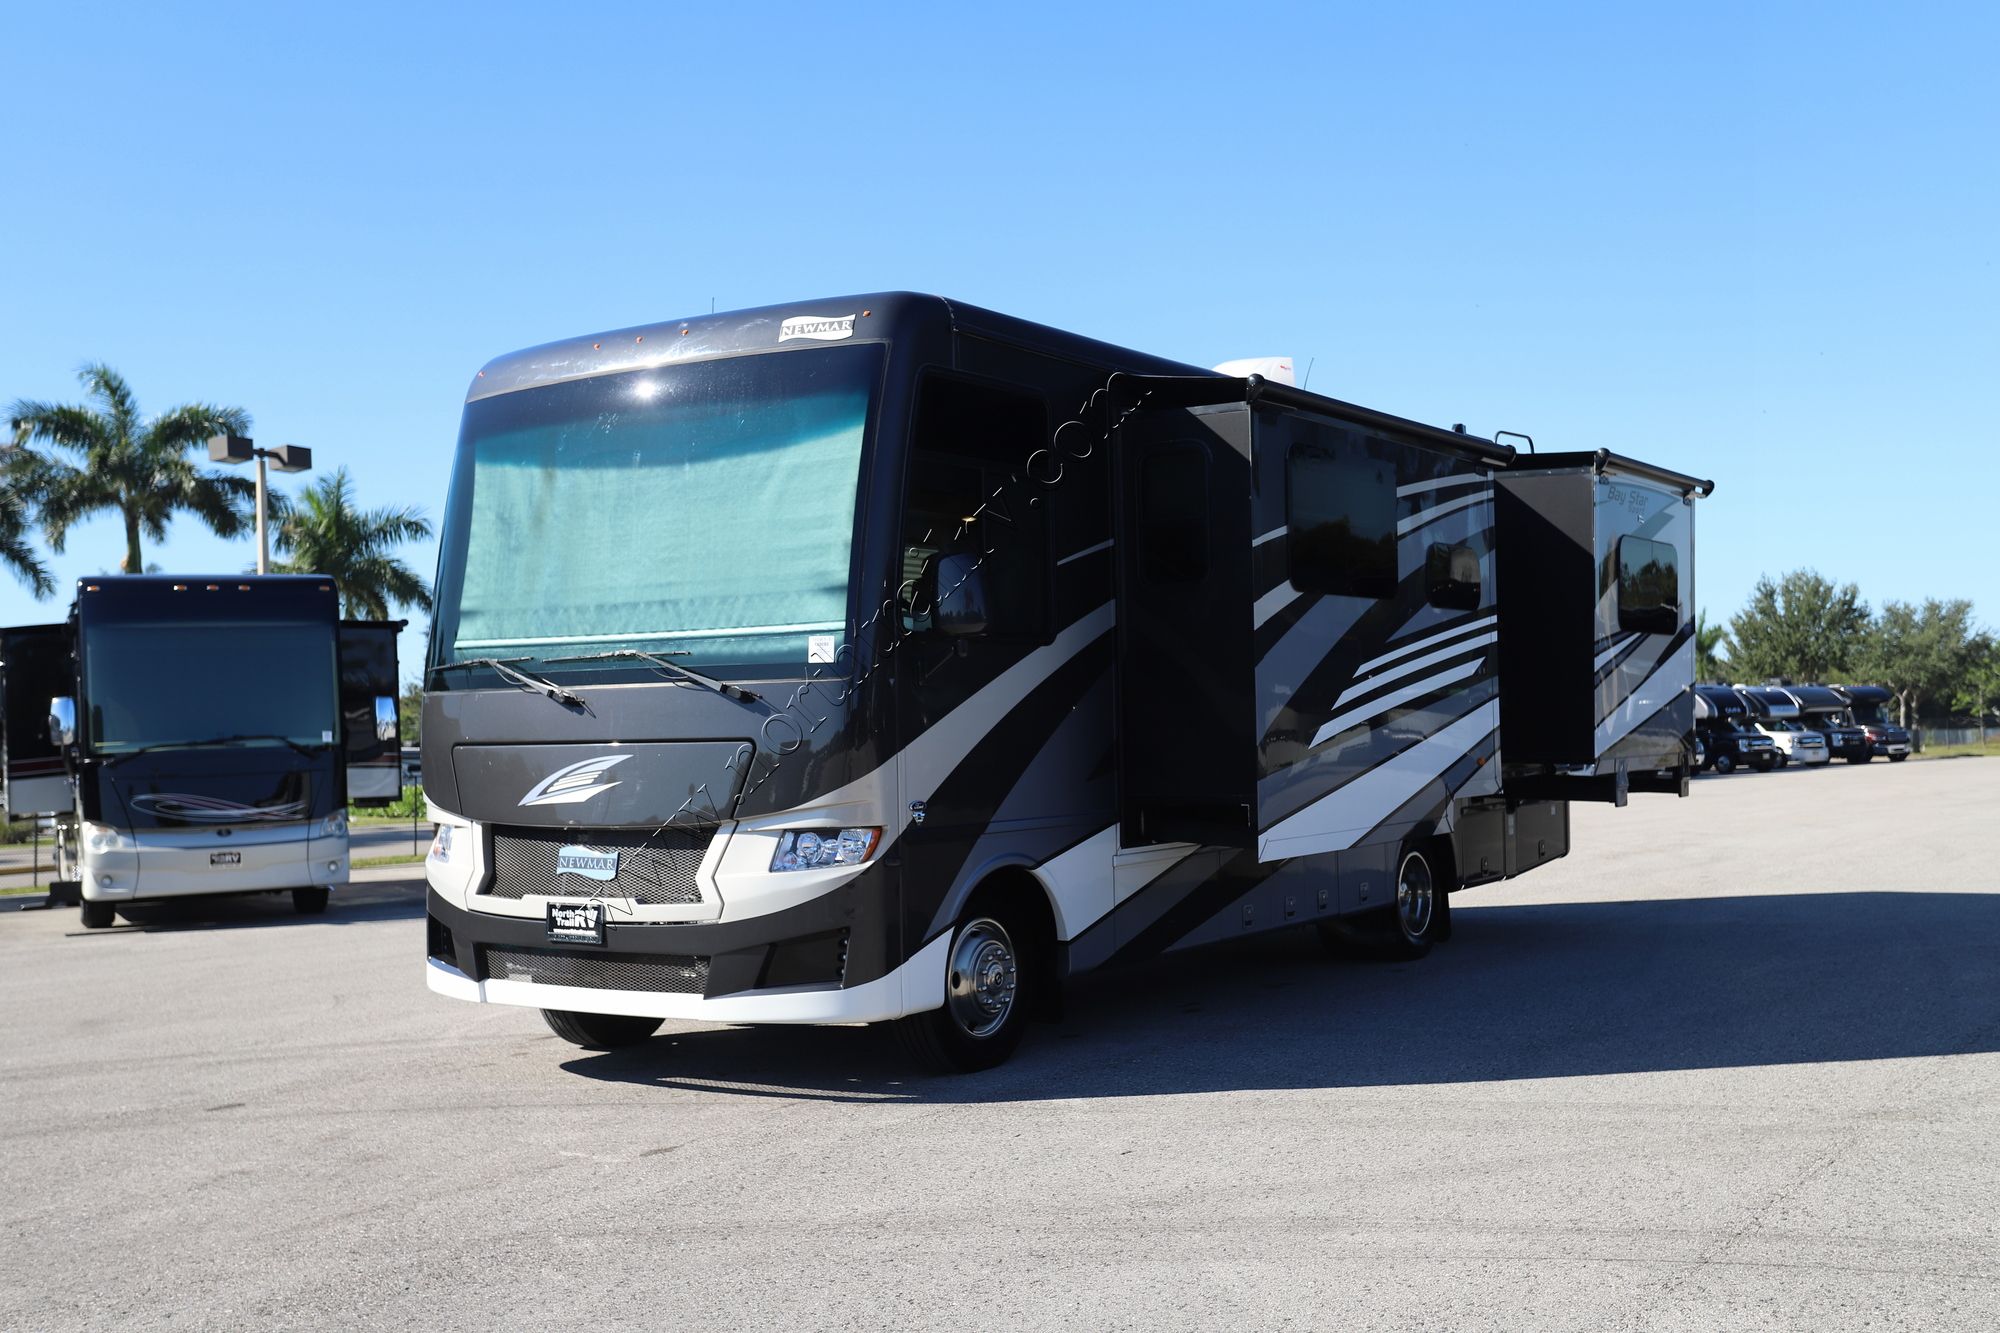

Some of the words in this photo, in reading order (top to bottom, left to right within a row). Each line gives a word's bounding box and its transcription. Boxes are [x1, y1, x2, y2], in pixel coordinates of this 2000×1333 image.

[781, 320, 852, 336] NEWMAR
[1608, 486, 1626, 505] Bay
[1628, 490, 1648, 506] Star
[560, 857, 615, 869] NEWMAR
[552, 908, 574, 918] North
[574, 909, 598, 928] RV
[556, 917, 574, 927] Trail
